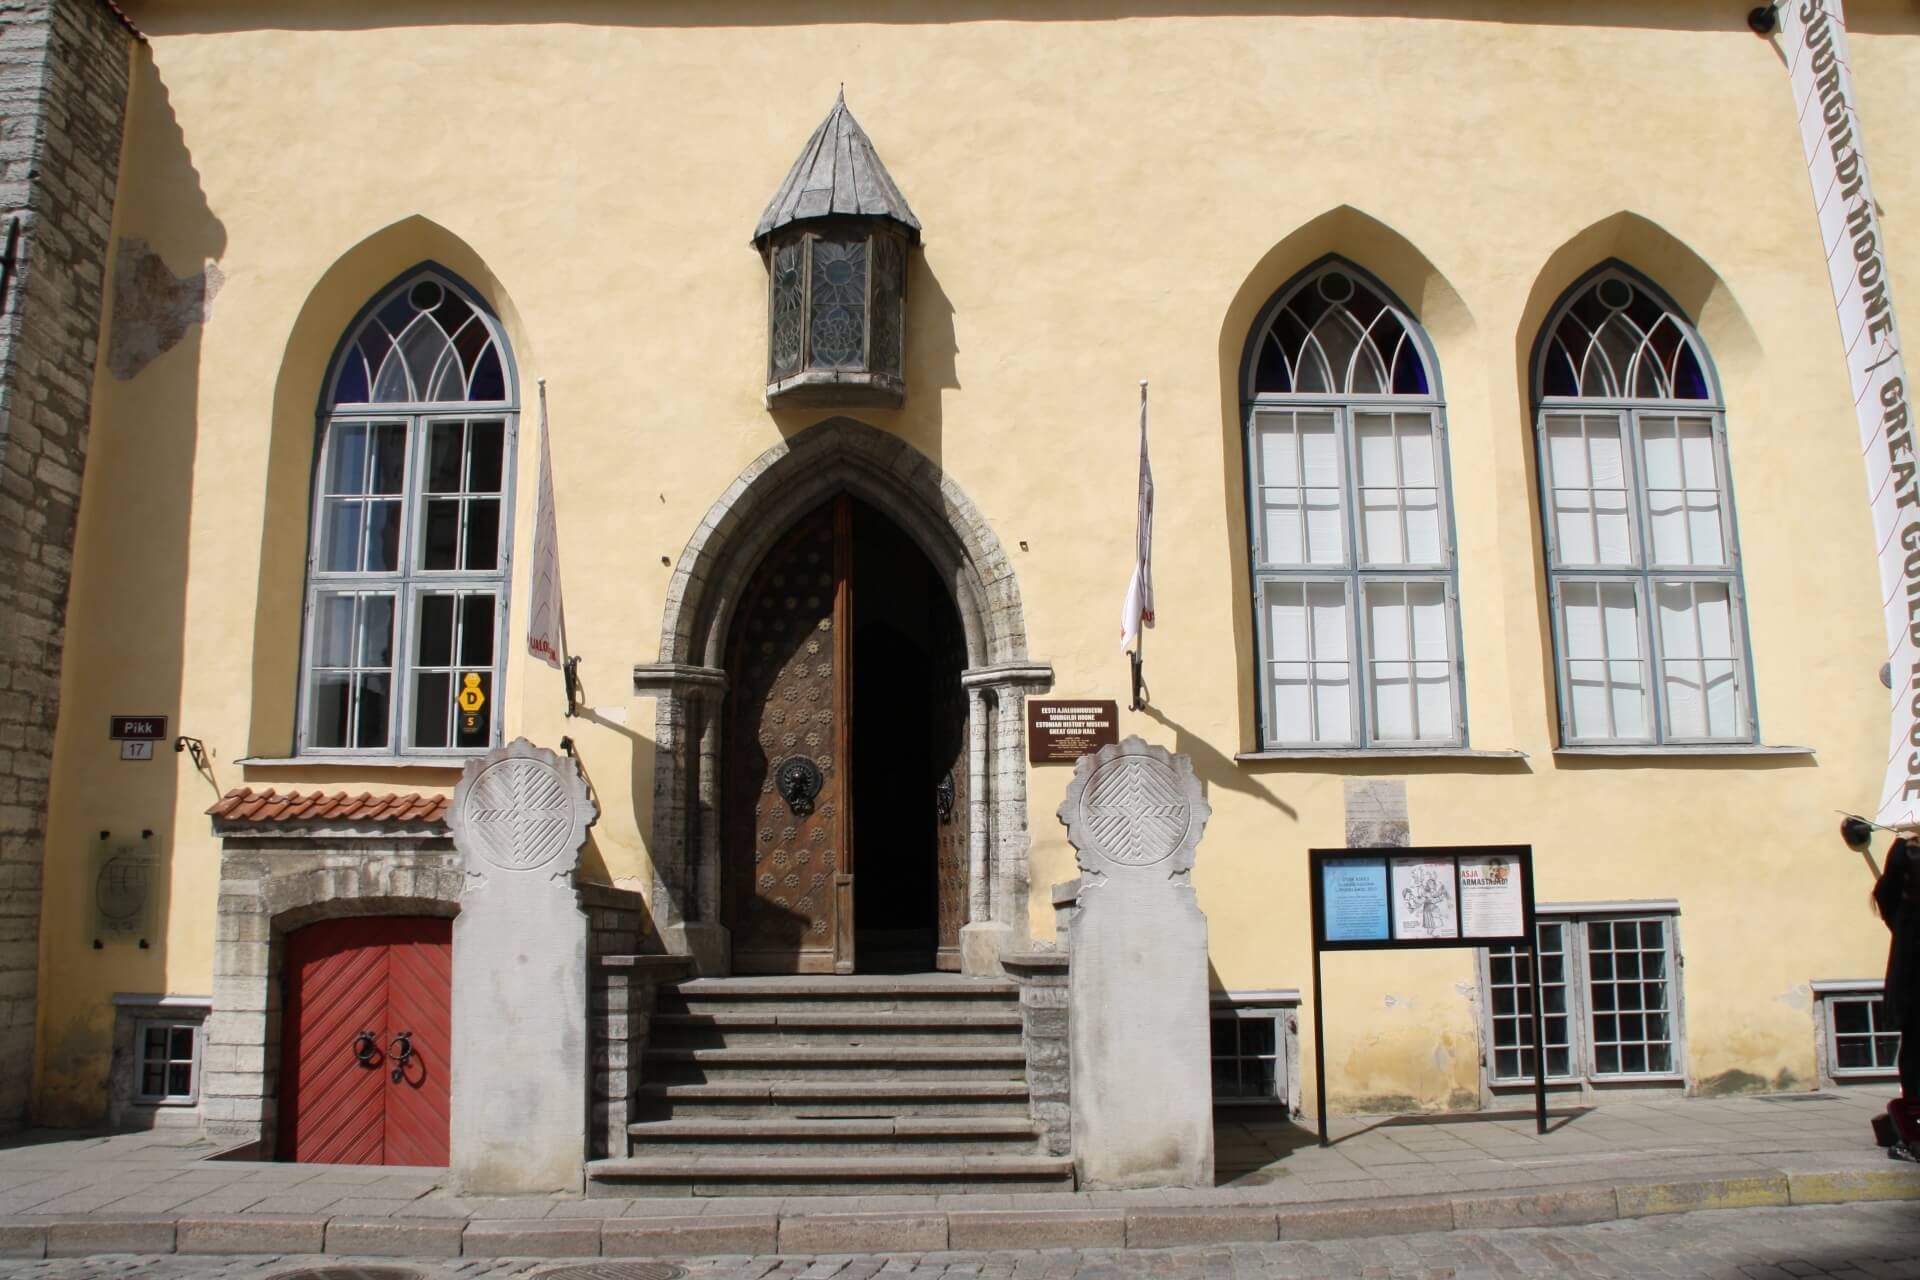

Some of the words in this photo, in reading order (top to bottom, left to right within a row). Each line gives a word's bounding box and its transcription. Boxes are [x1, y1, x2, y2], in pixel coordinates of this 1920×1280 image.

[1801, 0, 1863, 201] SUURGILDI
[1847, 203, 1893, 345] HOONE
[1880, 377, 1920, 509] GREAT
[466, 692, 478, 705] D
[124, 722, 152, 734] Pikk
[129, 743, 145, 756] 17
